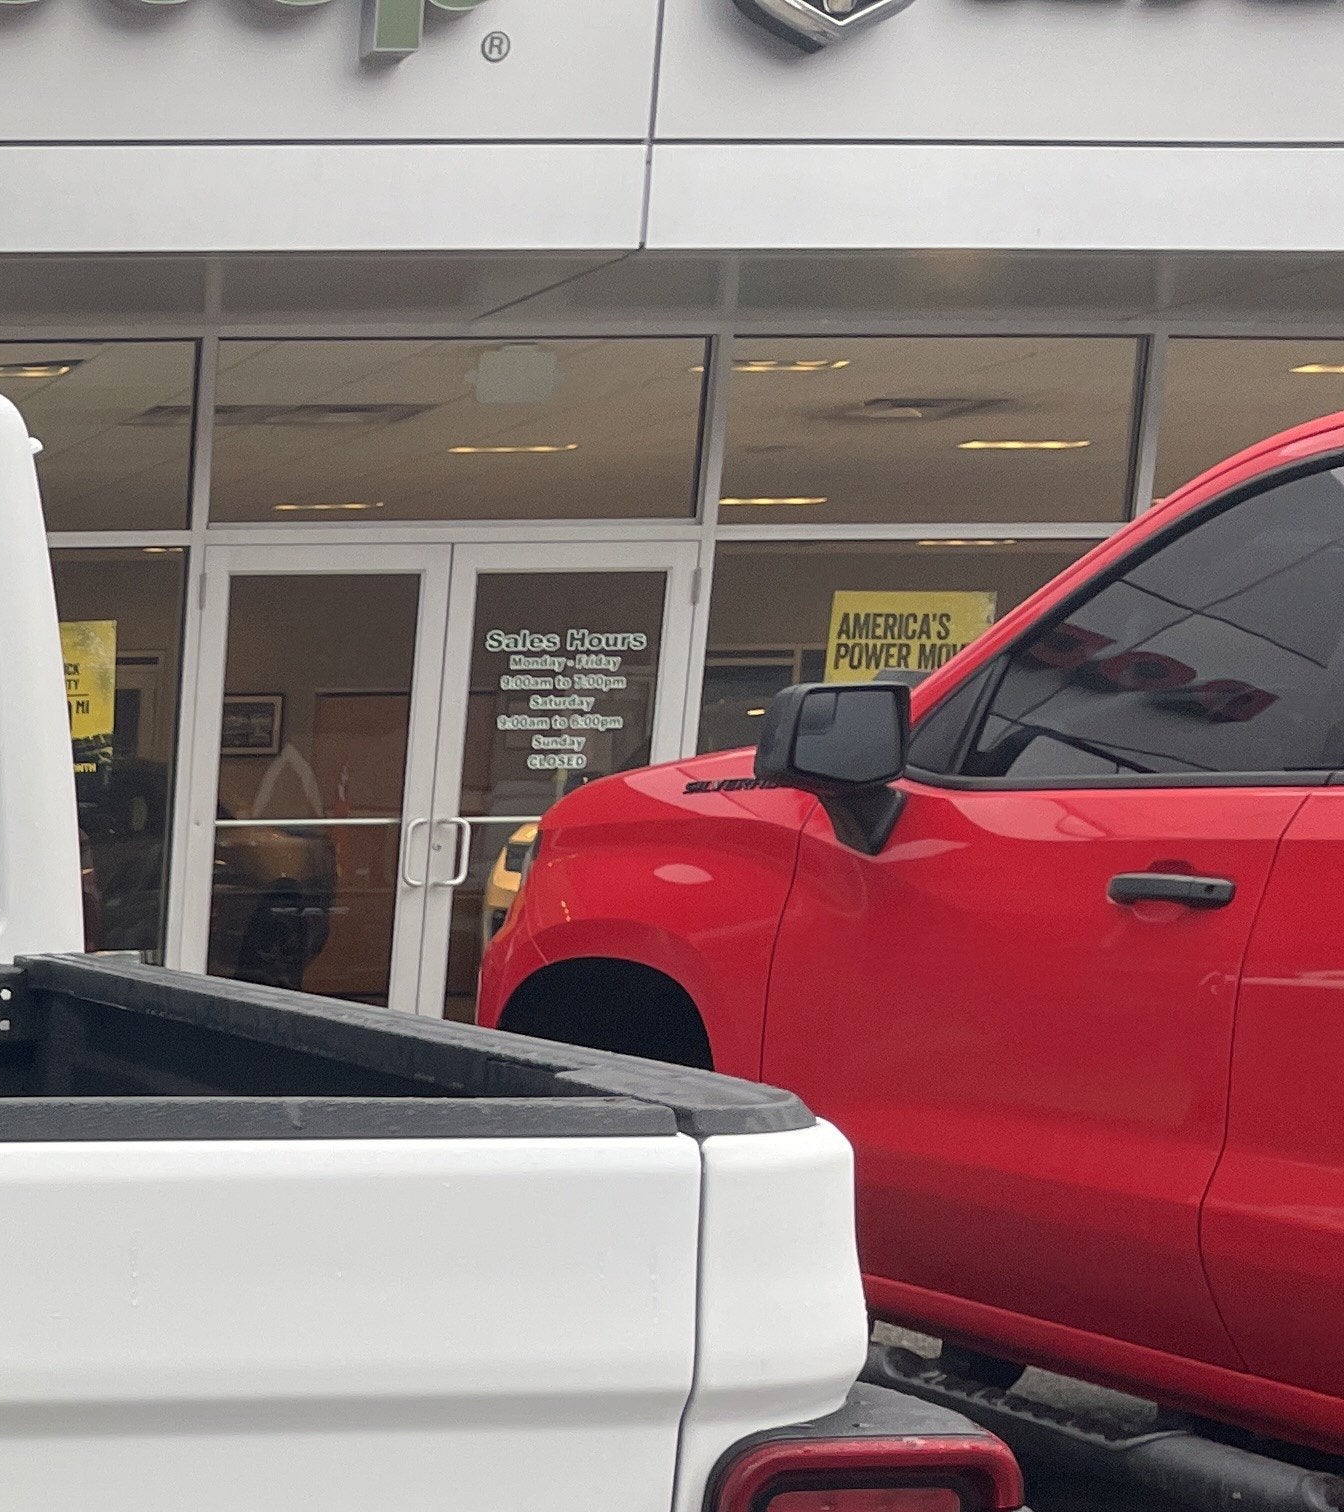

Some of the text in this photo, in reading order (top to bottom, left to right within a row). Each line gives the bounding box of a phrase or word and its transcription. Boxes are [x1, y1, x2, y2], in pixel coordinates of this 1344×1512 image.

[837, 611, 952, 641] AMERICA'S
[485, 629, 647, 651] Sales Hours
[510, 655, 566, 671] Monday
[575, 654, 621, 671] Friday
[833, 643, 911, 670] POWER
[500, 675, 553, 690] 9:00am
[555, 676, 572, 689] to
[529, 695, 595, 711] Saturday
[497, 715, 550, 730] 9:00am
[551, 715, 569, 729] to
[532, 734, 586, 751] Sunday
[527, 754, 587, 769] CLOSED
